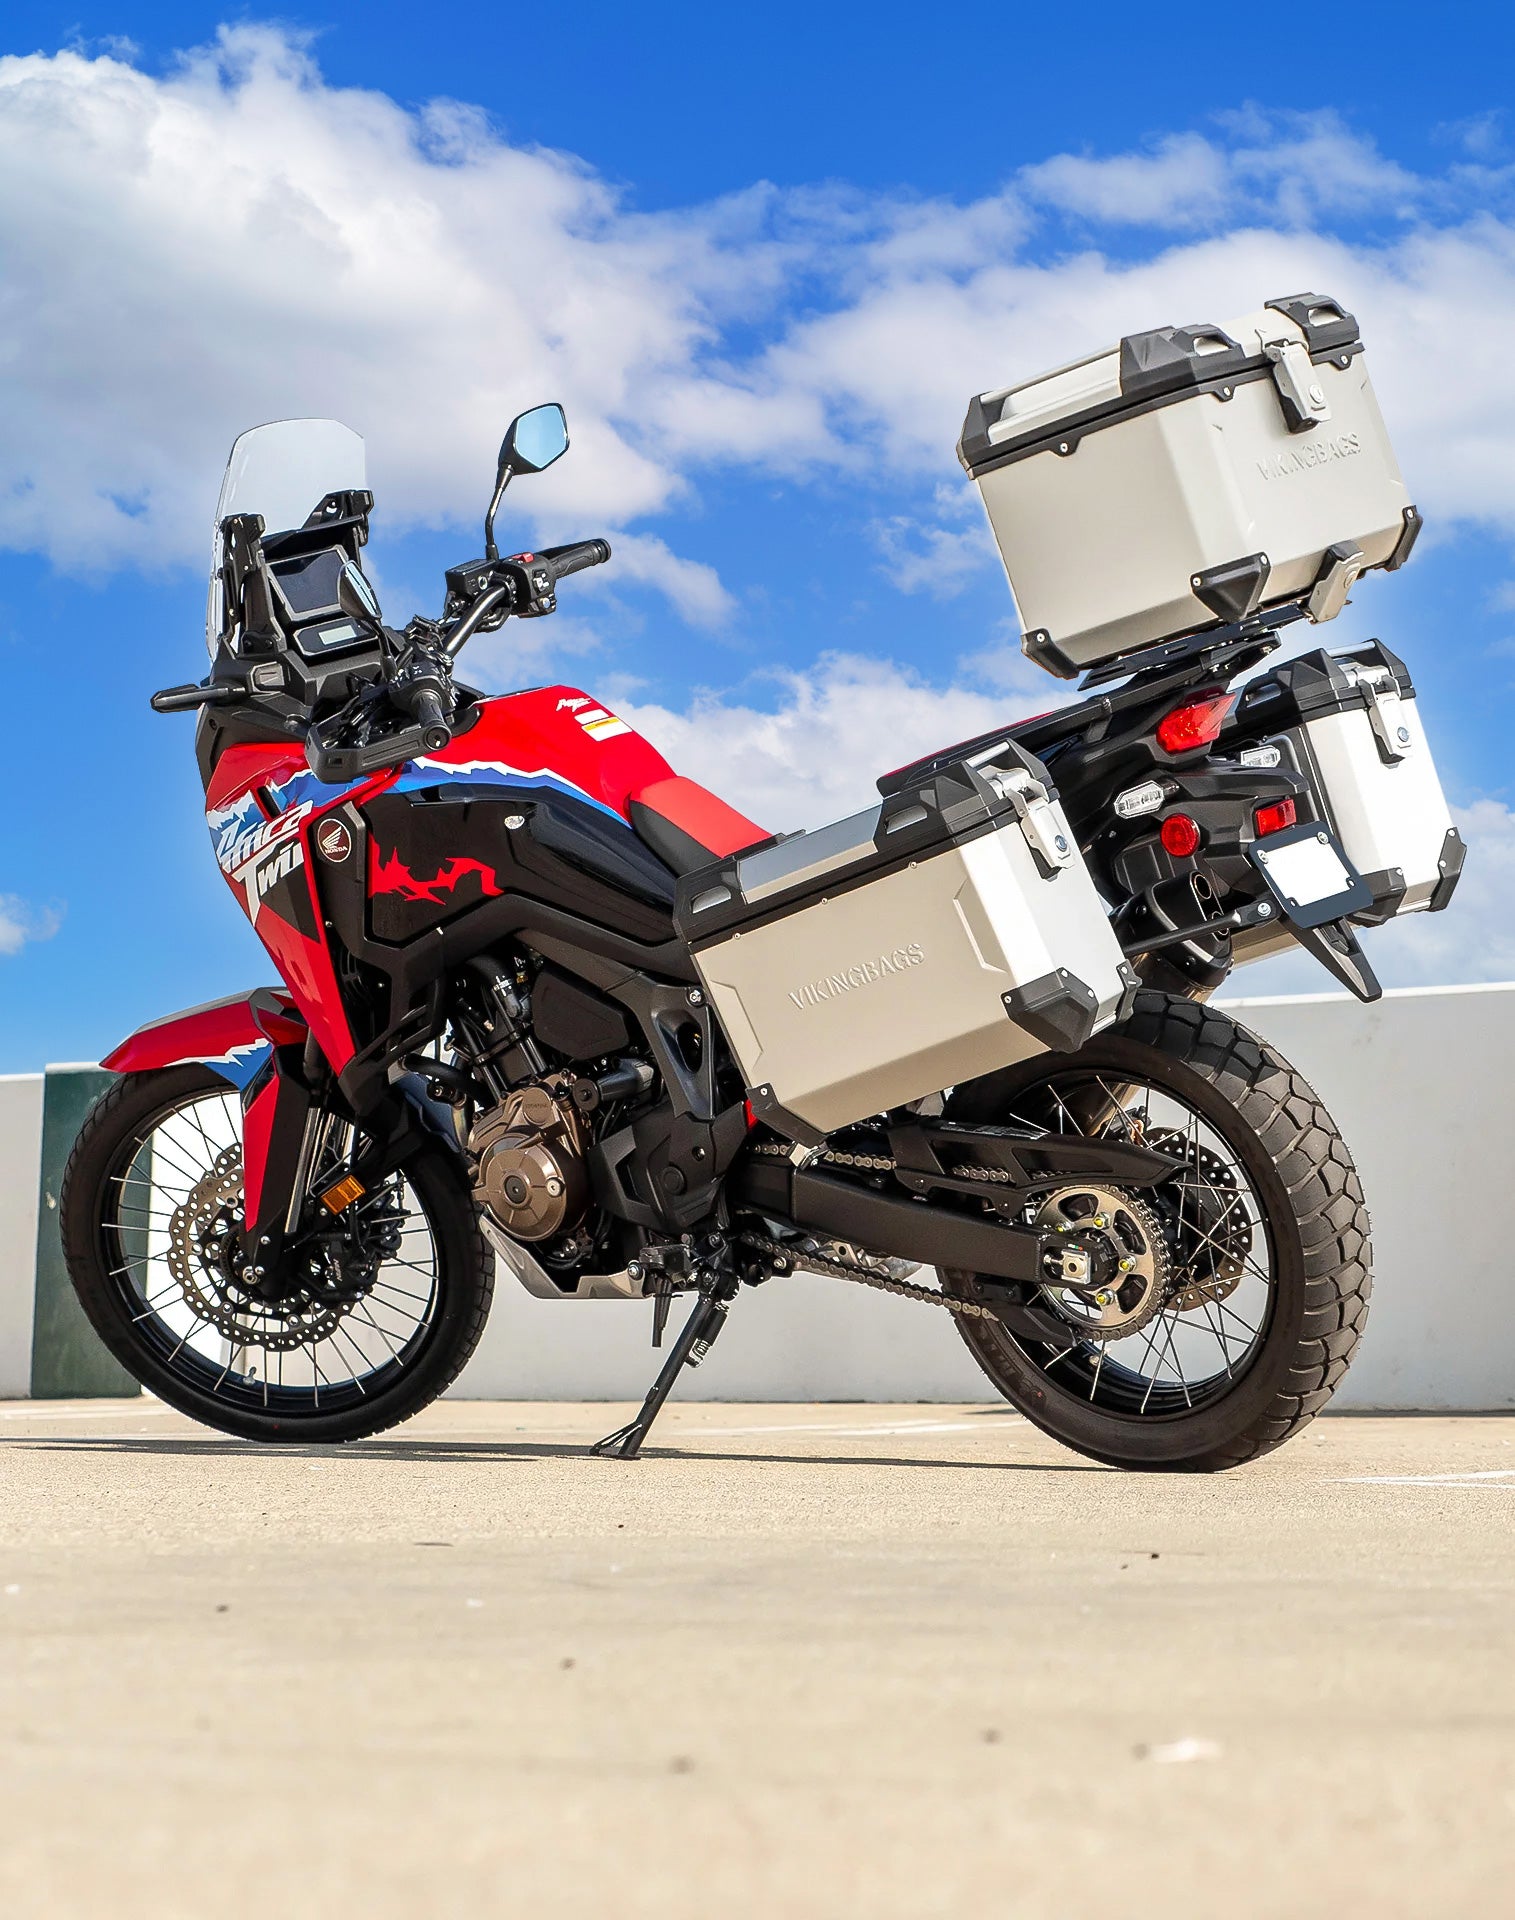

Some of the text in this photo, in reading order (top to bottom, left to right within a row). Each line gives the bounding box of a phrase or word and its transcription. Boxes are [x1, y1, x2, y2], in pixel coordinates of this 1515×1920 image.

[1256, 432, 1361, 481] VIKINGBAGS
[216, 800, 313, 874] Africa
[788, 943, 925, 1010] VIKINGBAGS
